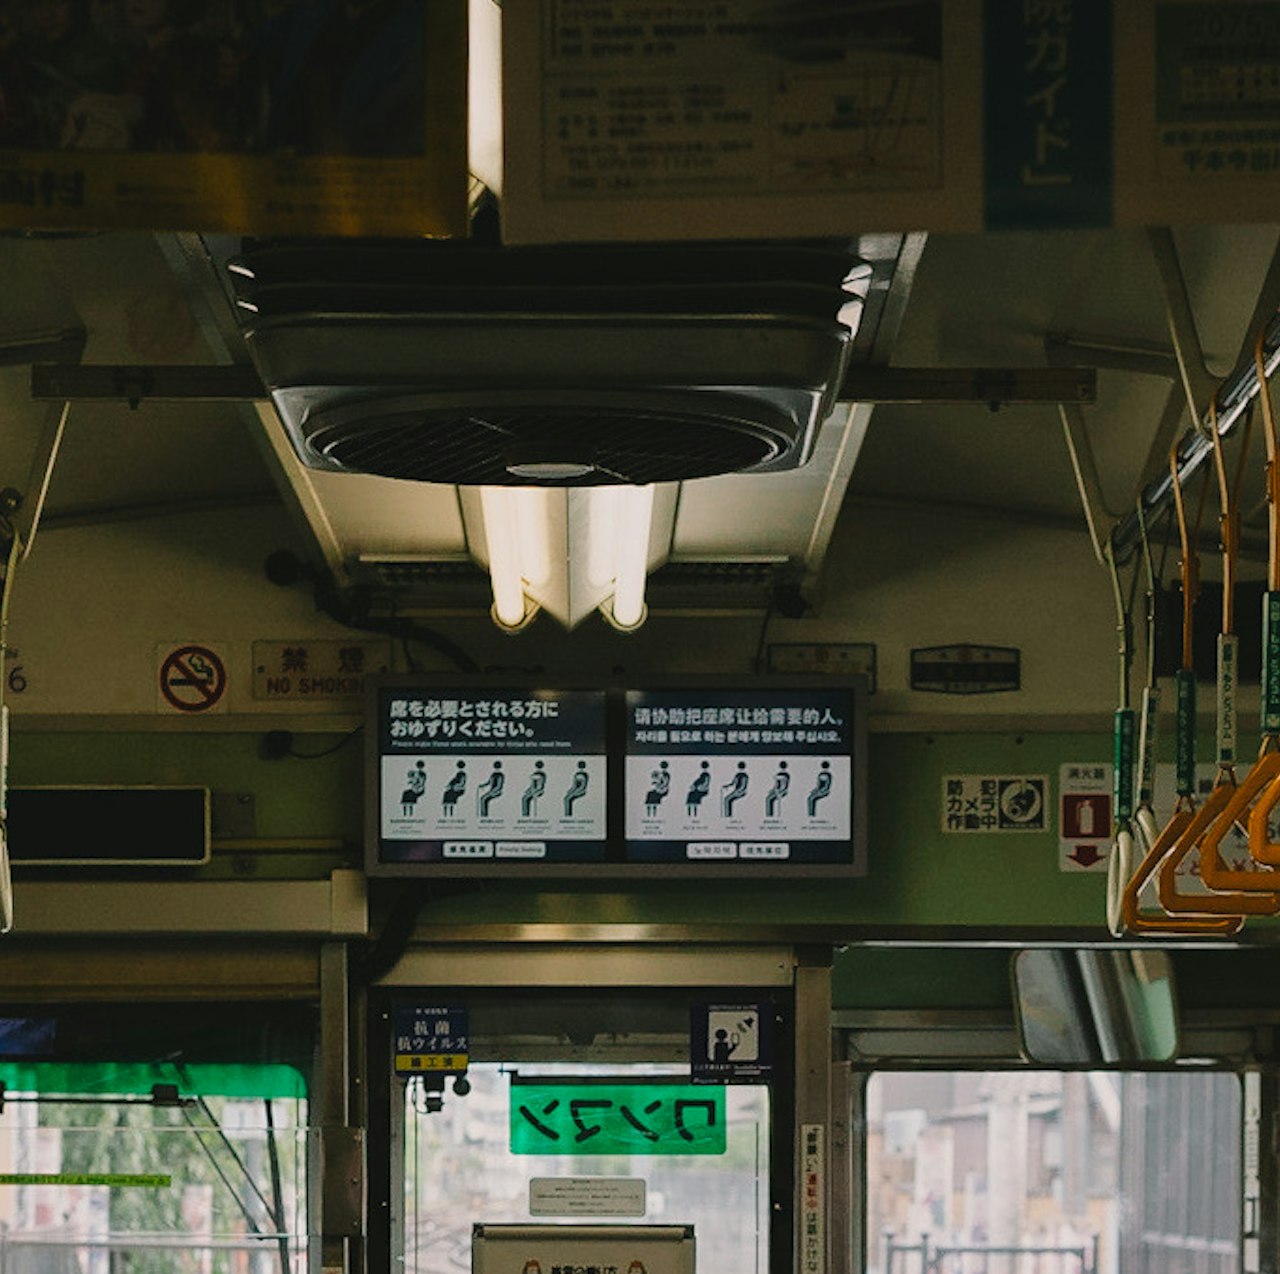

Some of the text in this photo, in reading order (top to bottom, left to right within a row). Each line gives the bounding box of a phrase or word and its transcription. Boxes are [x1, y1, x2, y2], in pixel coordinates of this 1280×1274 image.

[266, 676, 291, 695] NO
[390, 699, 560, 718] 席を必要とされる方に
[390, 719, 535, 738] おゆずりください。
[947, 797, 998, 813] カメラ
